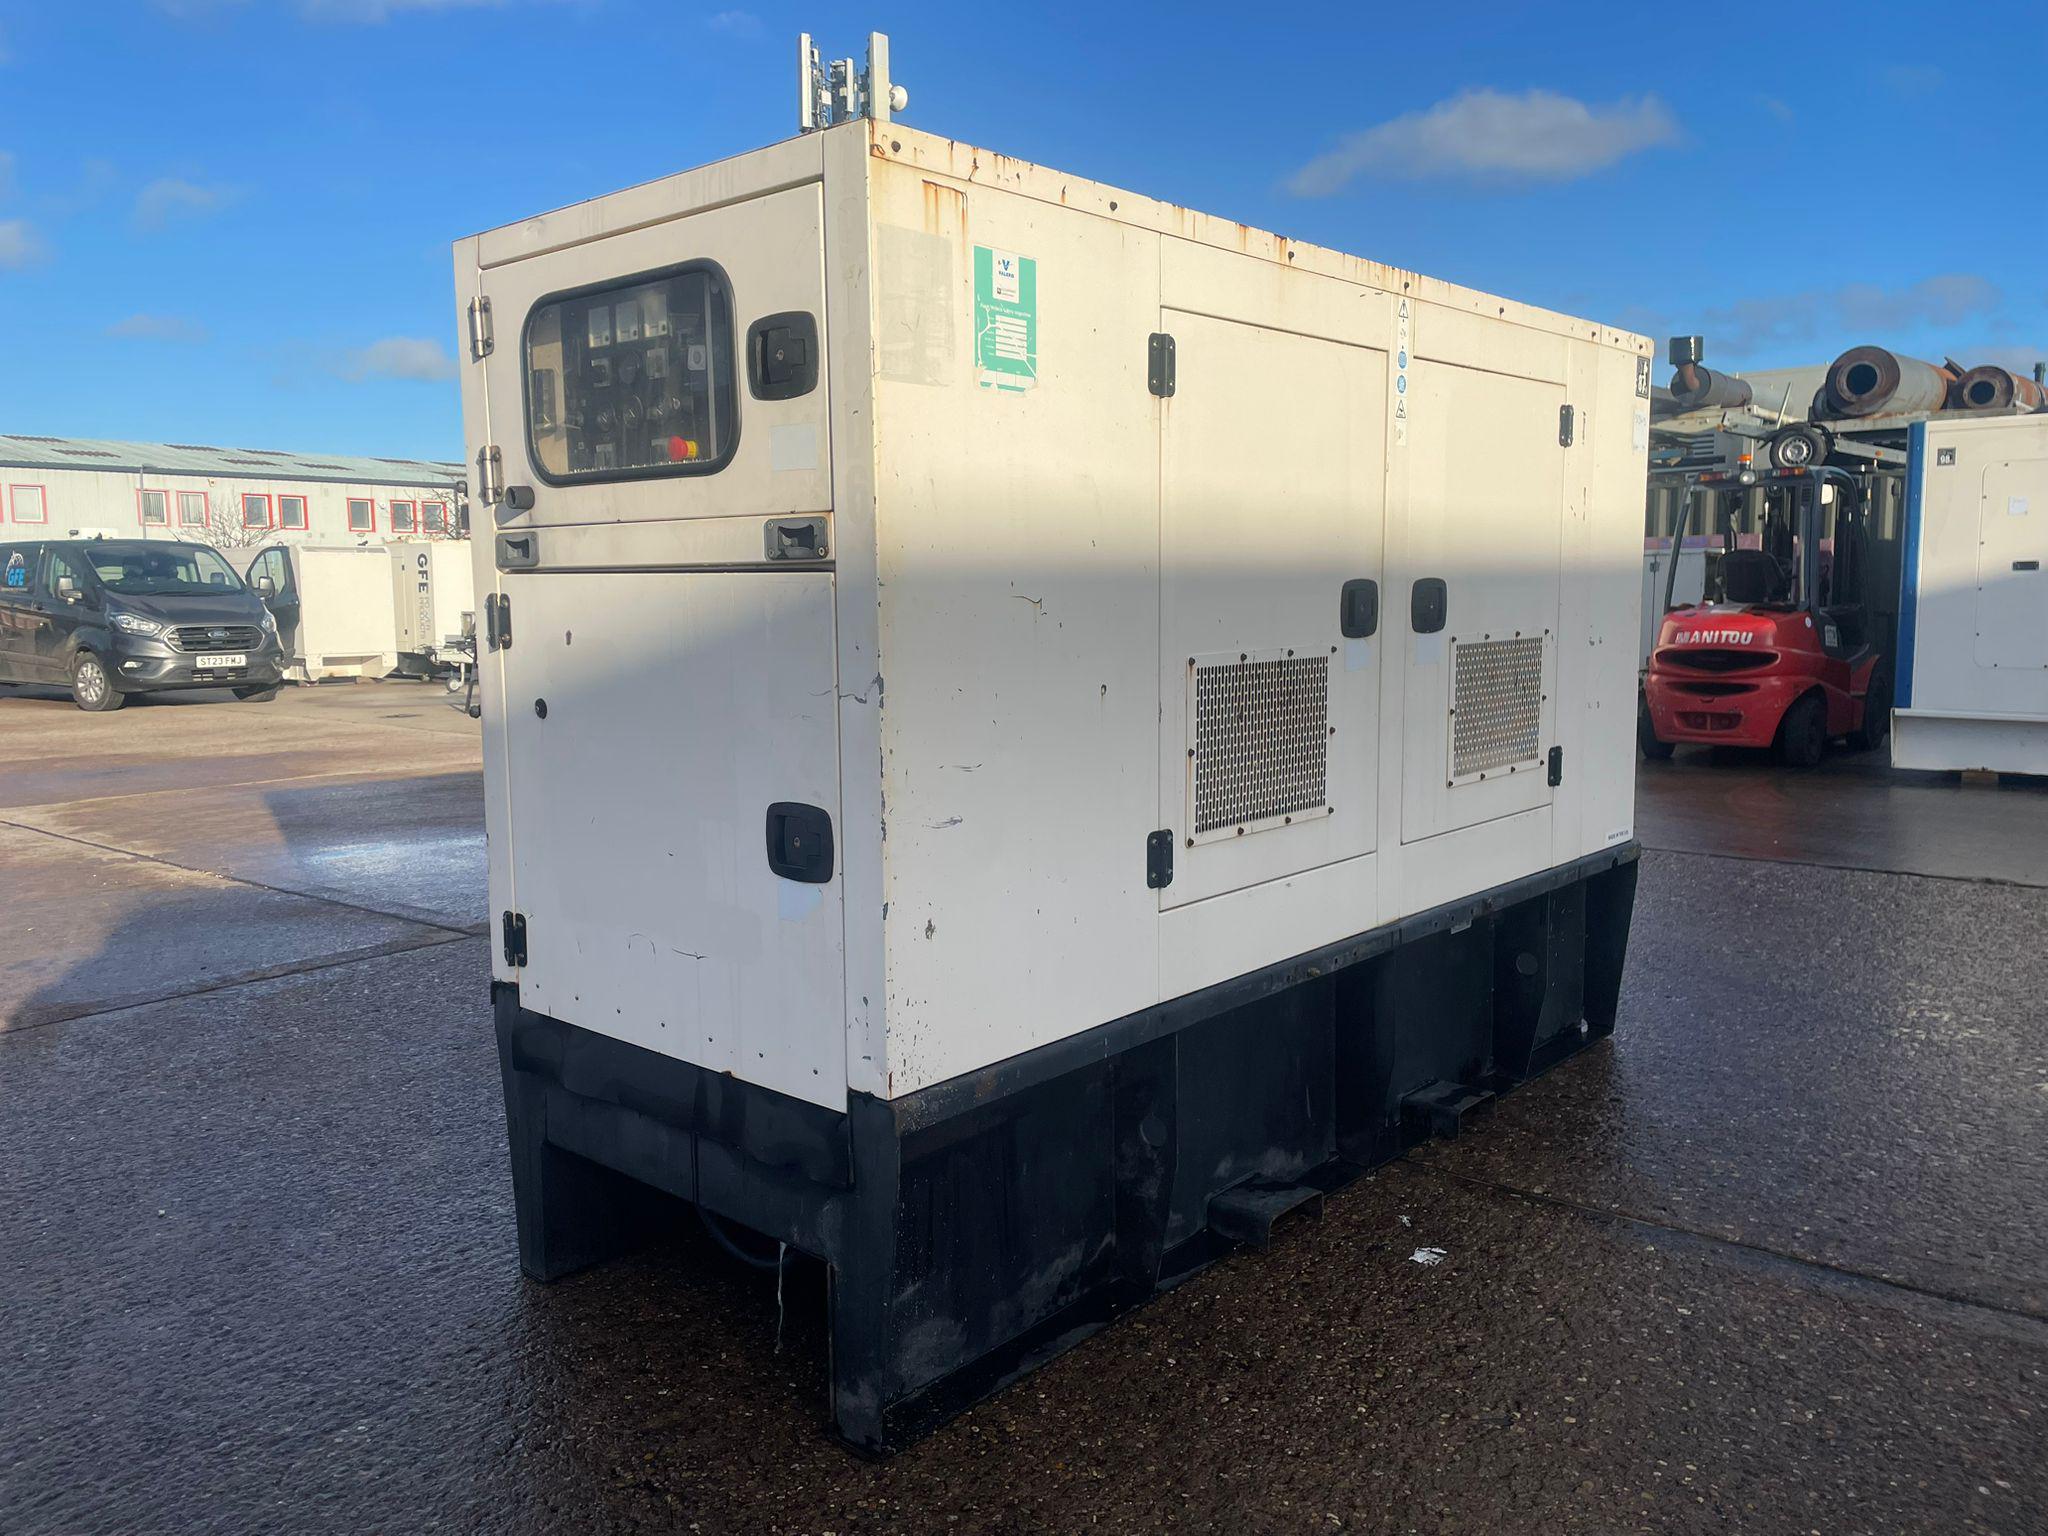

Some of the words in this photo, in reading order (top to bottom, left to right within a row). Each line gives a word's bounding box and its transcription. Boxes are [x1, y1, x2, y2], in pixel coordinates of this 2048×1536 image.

[417, 553, 428, 593] GFE
[1675, 630, 1753, 645] MANITOU
[200, 657, 224, 666] ST23
